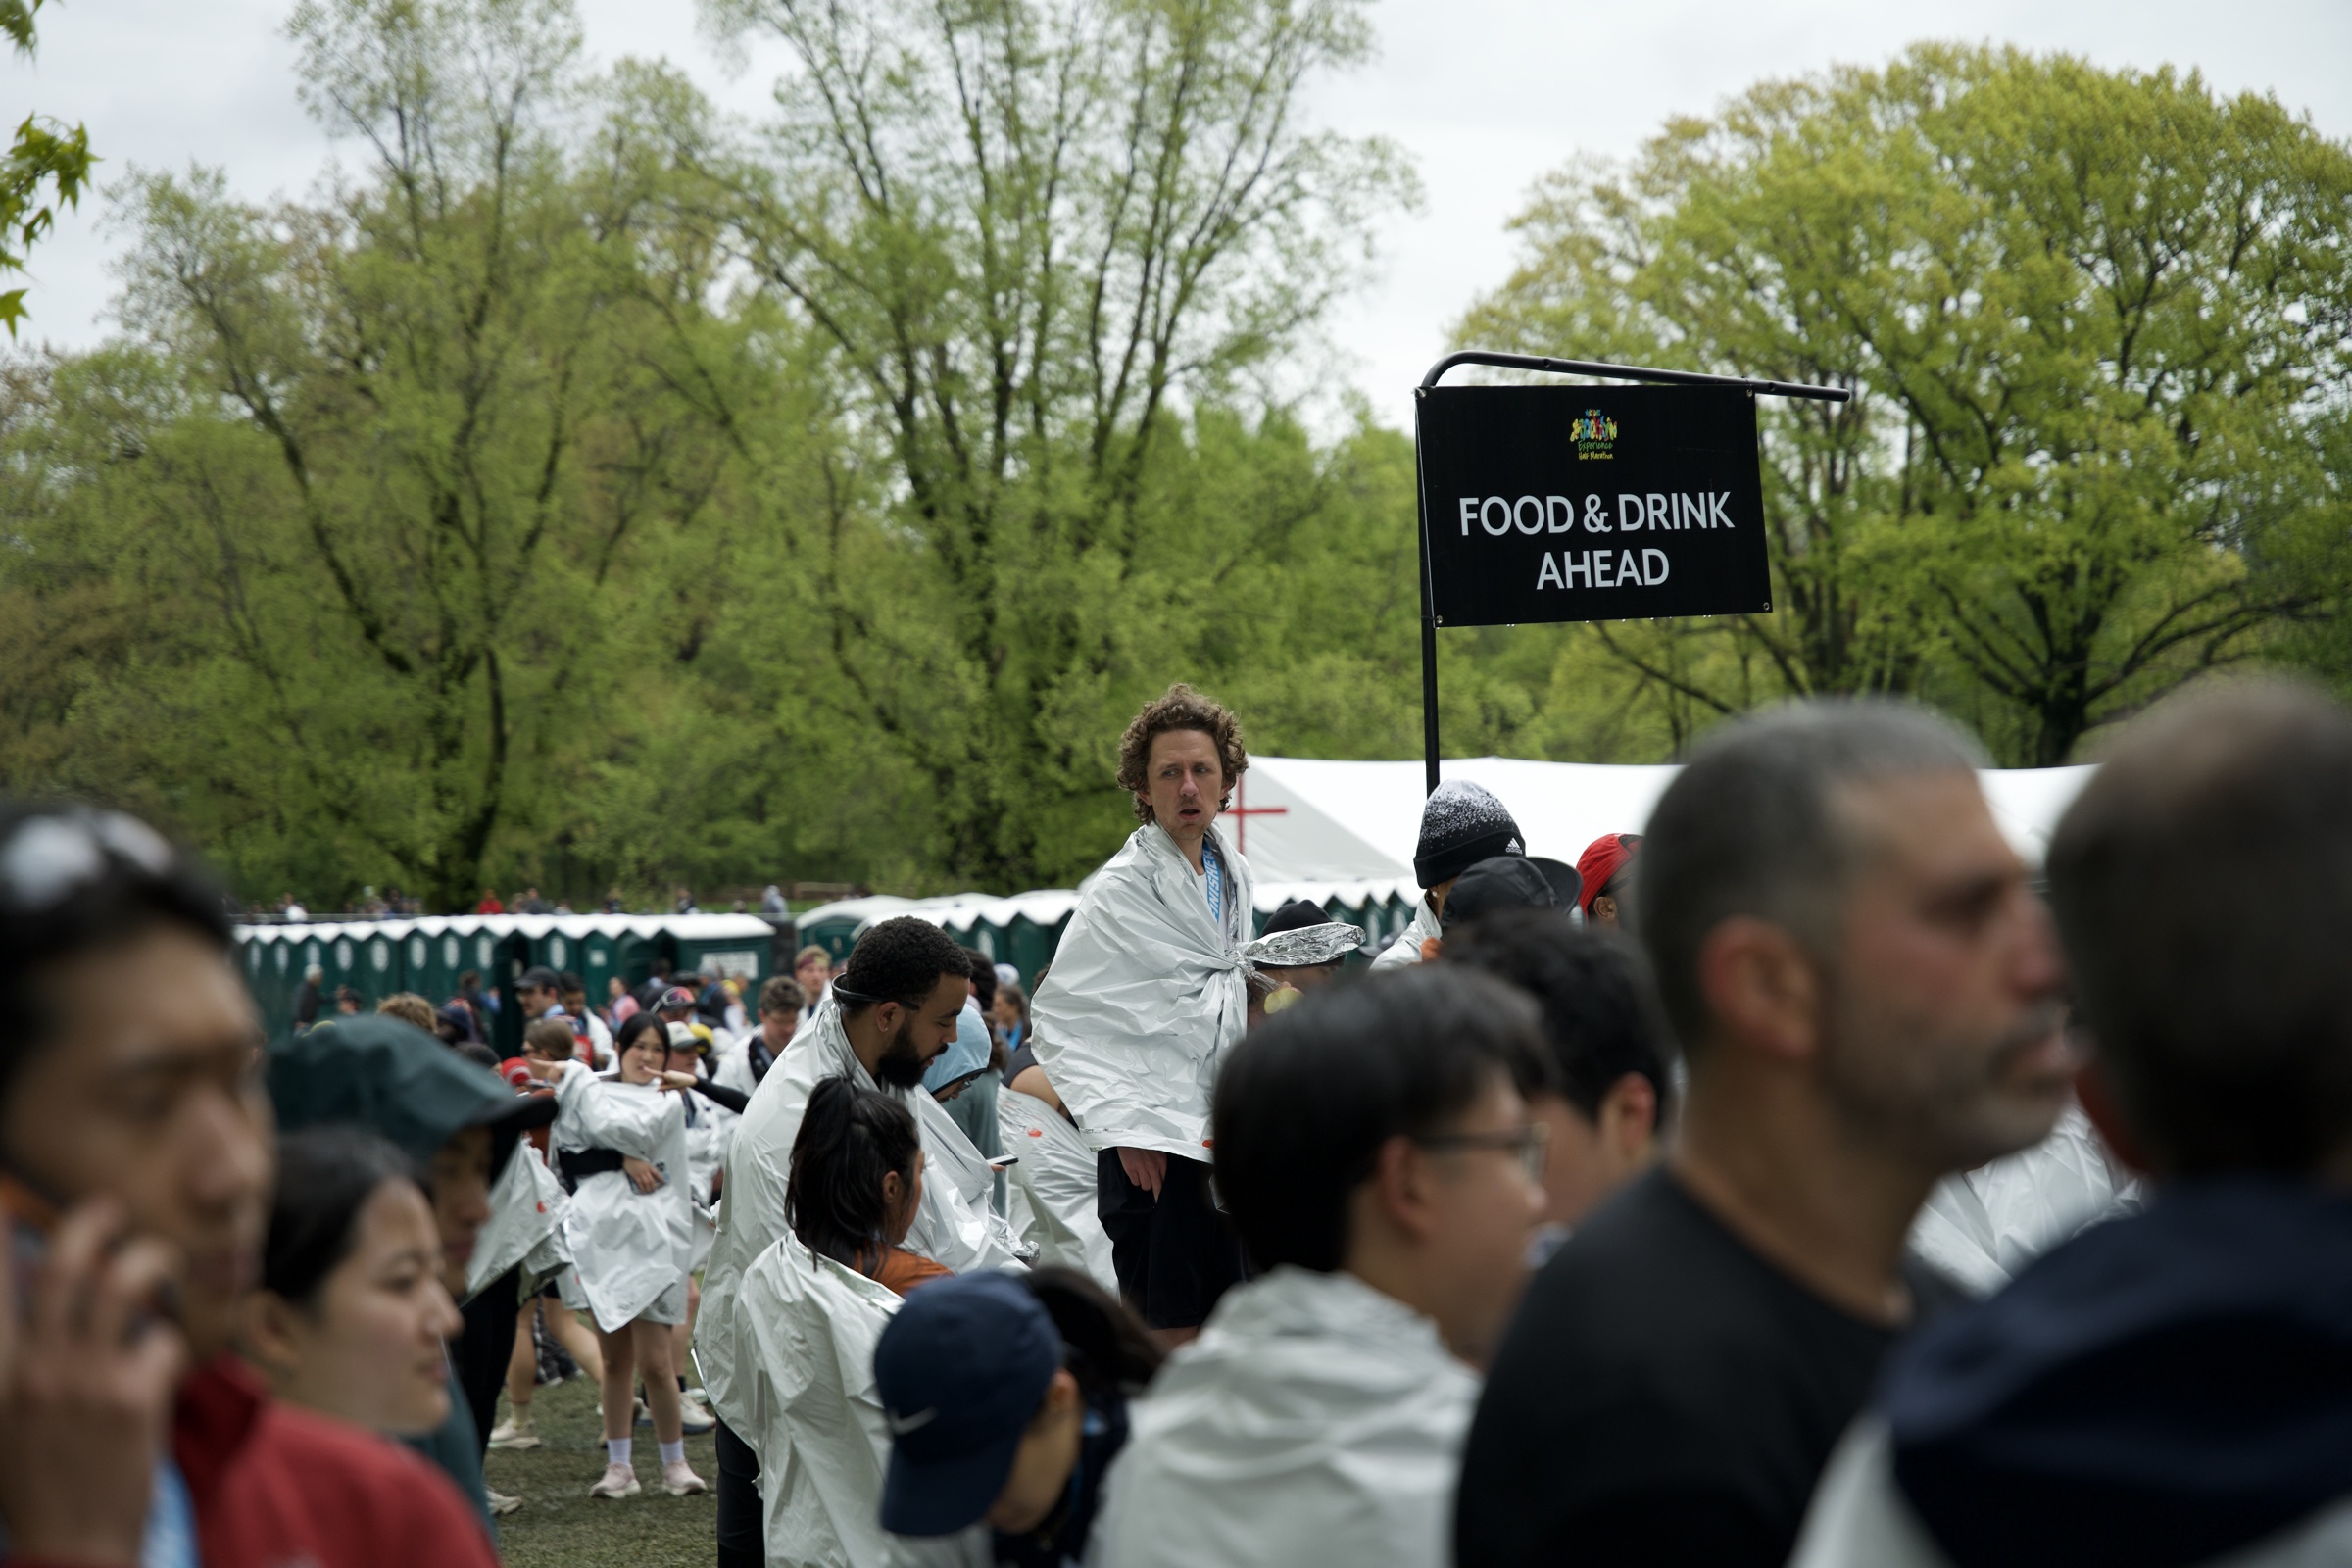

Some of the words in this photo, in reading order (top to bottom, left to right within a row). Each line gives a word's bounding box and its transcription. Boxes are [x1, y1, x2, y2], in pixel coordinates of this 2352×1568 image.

[1460, 495, 1574, 535] FOOD
[1584, 494, 1612, 532] &
[1619, 492, 1735, 531] DRINK
[1537, 549, 1669, 590] AHEAD
